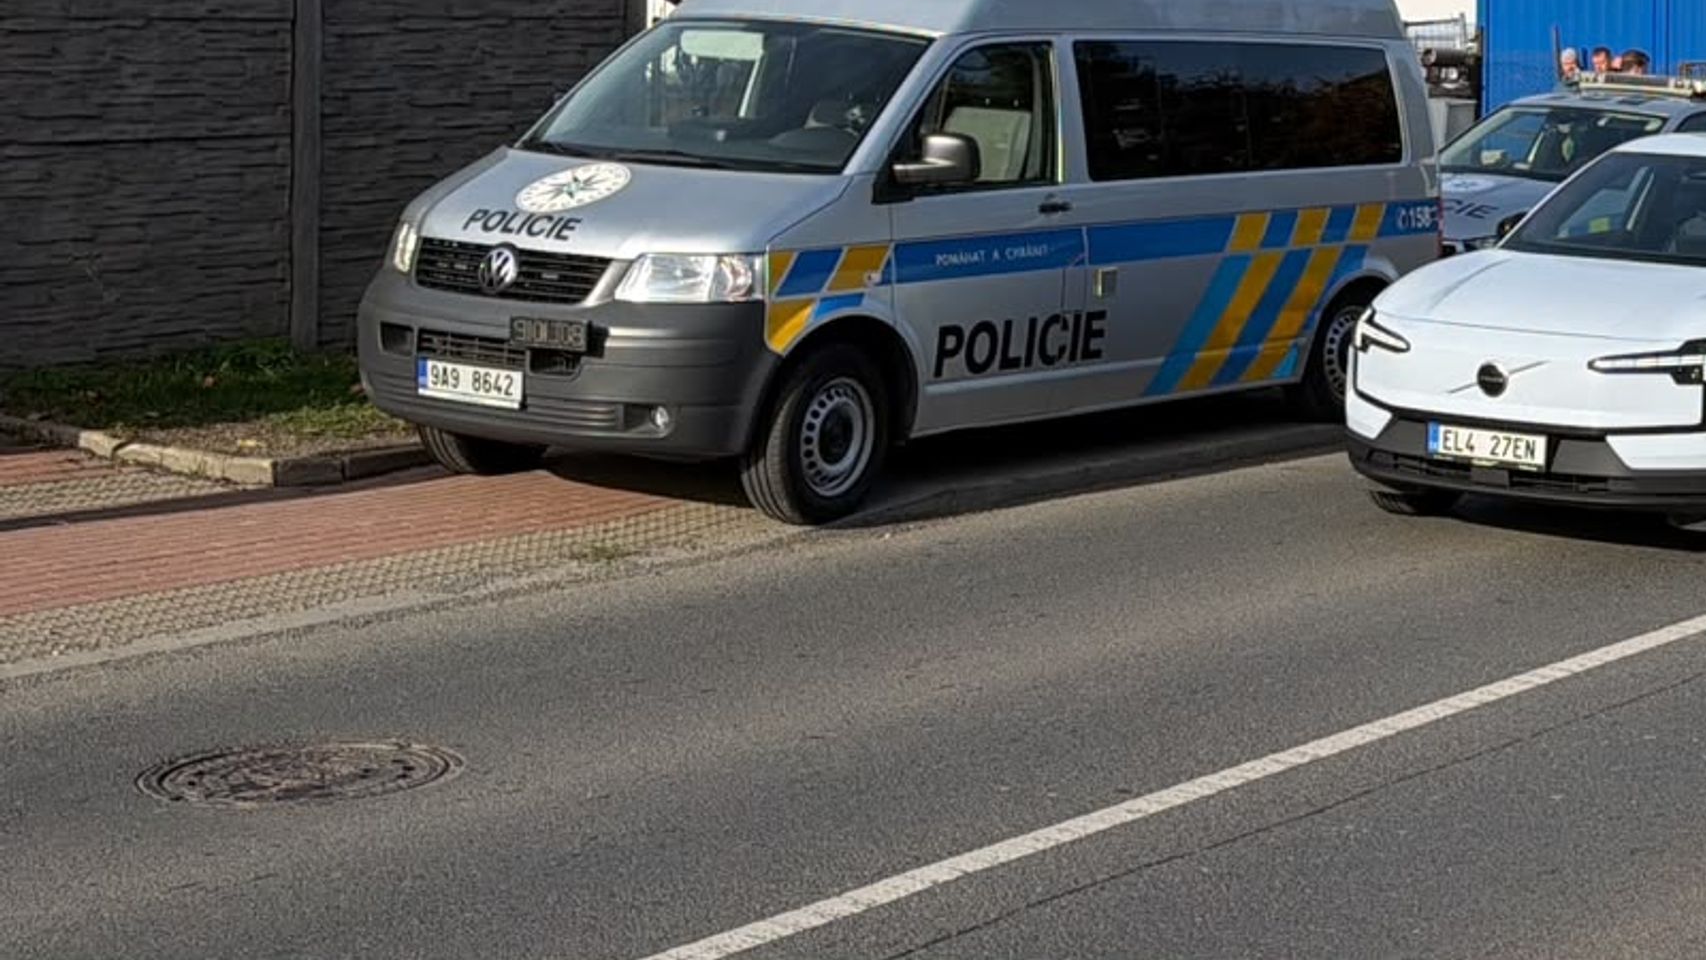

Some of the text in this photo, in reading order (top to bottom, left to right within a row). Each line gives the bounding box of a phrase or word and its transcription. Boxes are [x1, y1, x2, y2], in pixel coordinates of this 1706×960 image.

[462, 208, 582, 241] POLICIE
[933, 309, 1108, 379] POLICIE
[430, 364, 514, 397] 9A9 8642
[1442, 428, 1537, 461] EL4 27EN
